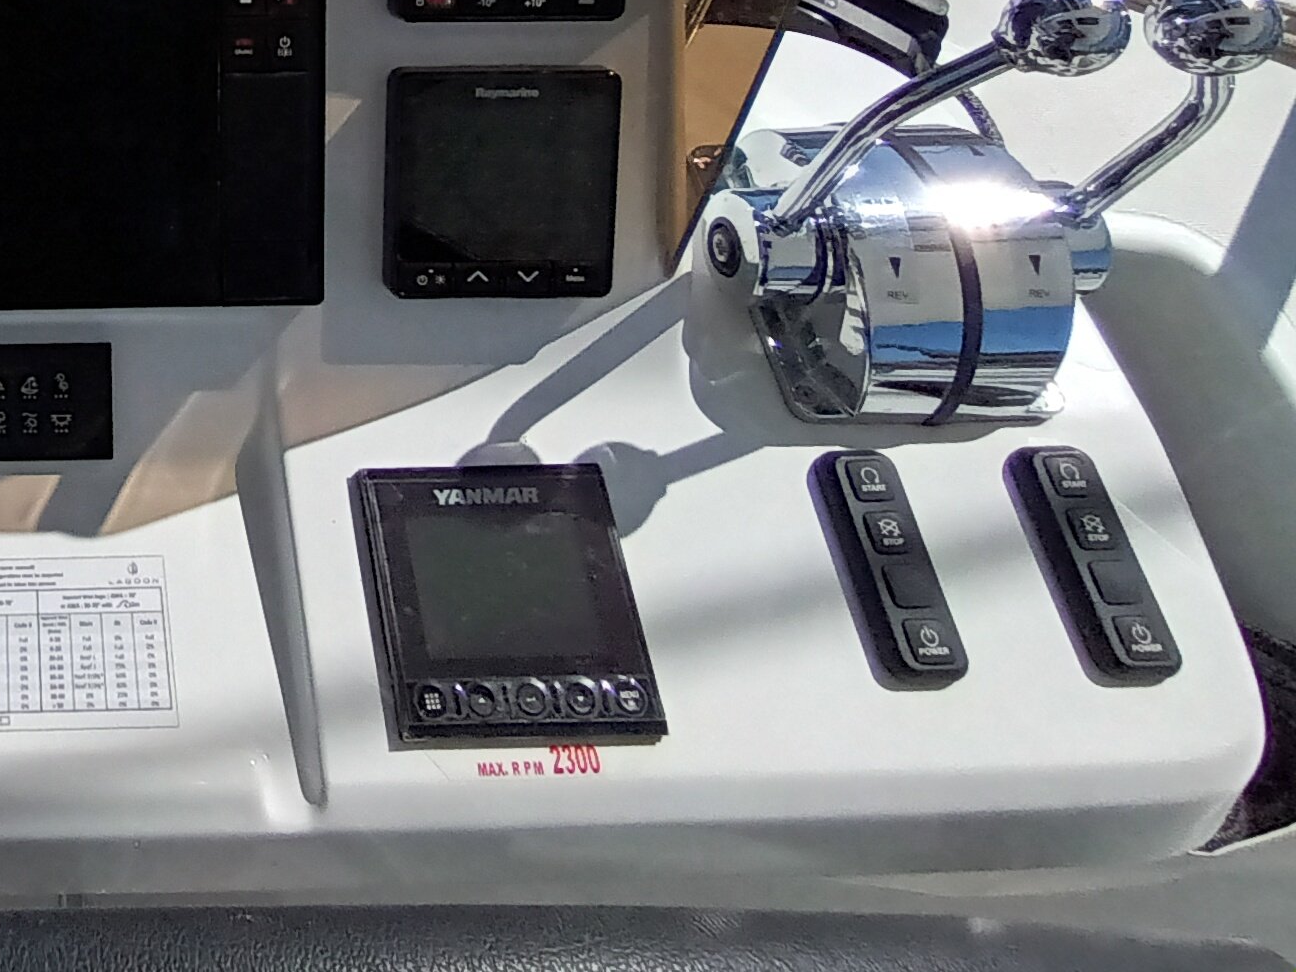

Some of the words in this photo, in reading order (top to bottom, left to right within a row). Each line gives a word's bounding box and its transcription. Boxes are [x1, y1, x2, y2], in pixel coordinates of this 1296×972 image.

[475, 87, 540, 99] Raymarine
[887, 290, 909, 300] REV
[1028, 288, 1050, 298] REV
[861, 484, 886, 492] START
[433, 487, 539, 506] YANMAR
[882, 537, 904, 546] STOP
[919, 647, 950, 656] POWER
[1132, 643, 1163, 652] POWER
[477, 761, 509, 776] MAX.
[549, 744, 601, 774] 2300
